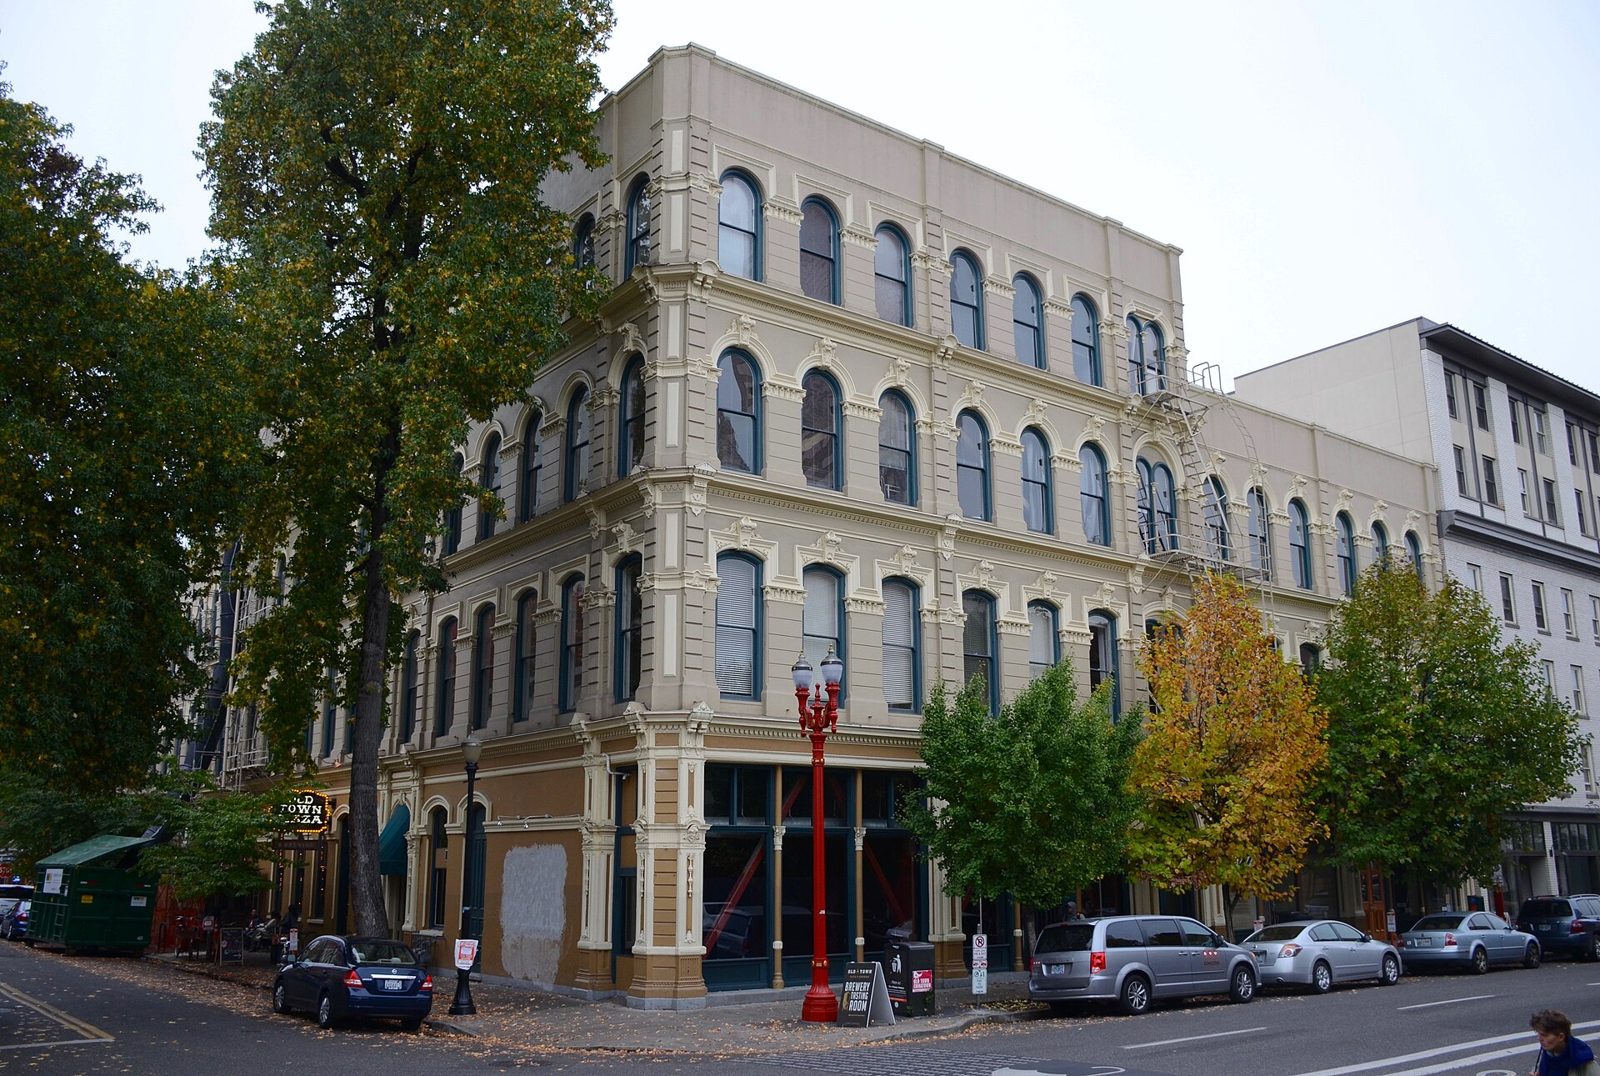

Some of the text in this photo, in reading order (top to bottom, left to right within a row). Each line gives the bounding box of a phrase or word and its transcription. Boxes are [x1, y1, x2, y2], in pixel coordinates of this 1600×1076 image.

[280, 804, 323, 814] TOWN
[844, 981, 870, 992] BREWERY
[850, 991, 869, 1000] TASTING
[848, 1000, 868, 1012] ROOM
